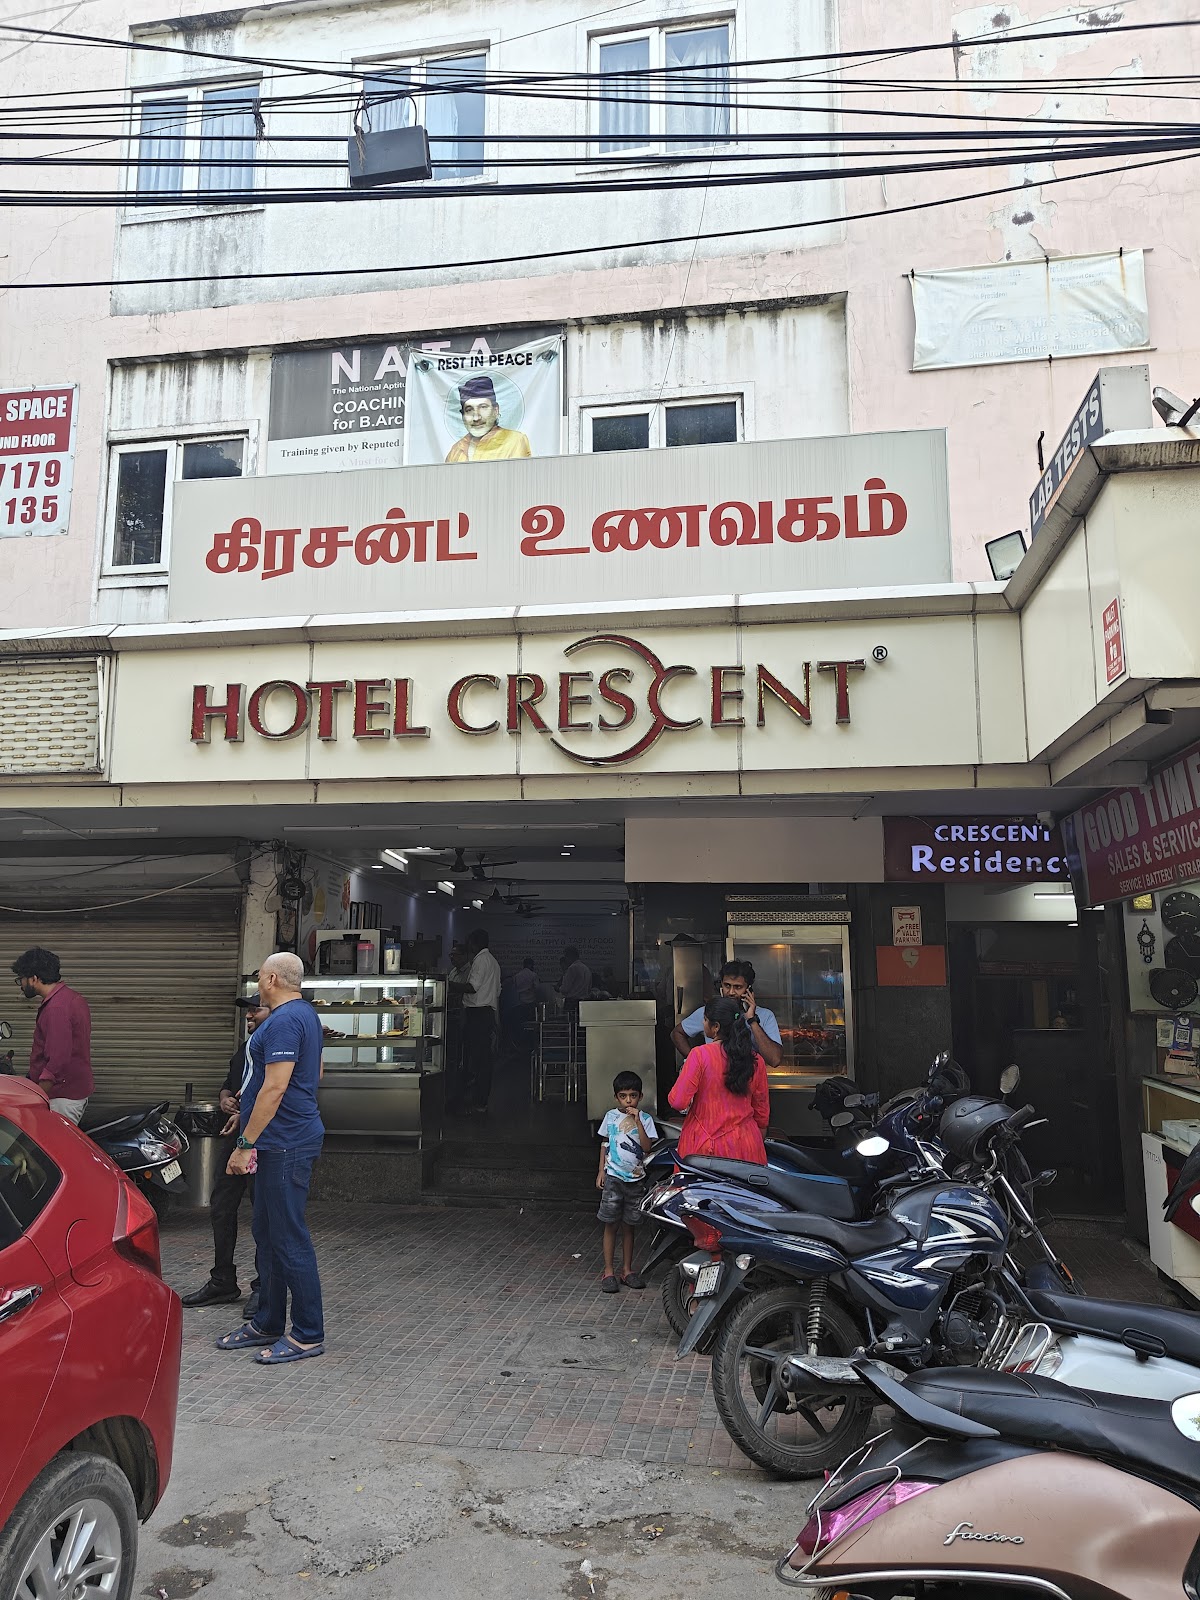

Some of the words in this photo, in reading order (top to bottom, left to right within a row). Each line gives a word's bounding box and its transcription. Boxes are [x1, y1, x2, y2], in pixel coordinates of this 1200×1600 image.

[437, 357, 466, 371] REST
[471, 355, 484, 368] IN
[489, 353, 533, 366] PEACE
[348, 384, 381, 393] National
[6, 396, 68, 421] SPACE
[332, 418, 355, 430] for
[360, 414, 403, 428] B.Arc
[21, 433, 56, 447] FLOOR
[281, 448, 319, 457] Training
[321, 445, 345, 455] given
[347, 443, 358, 453] by
[361, 438, 400, 450] Reputed
[1031, 468, 1053, 525] LAB
[1055, 388, 1099, 481] TESTS
[5, 495, 59, 525] 135
[205, 507, 477, 580] கிரசன்ட்
[520, 478, 908, 556] உணவகம்
[190, 677, 431, 744] HOTEL
[446, 645, 867, 748] CRESCENT
[1084, 792, 1140, 852] GOOD
[1107, 844, 1141, 875] SALES
[1142, 840, 1153, 865] &
[1152, 820, 1200, 861] SERVIC
[1119, 876, 1143, 893] SERVICE
[1146, 865, 1174, 887] BATTERY
